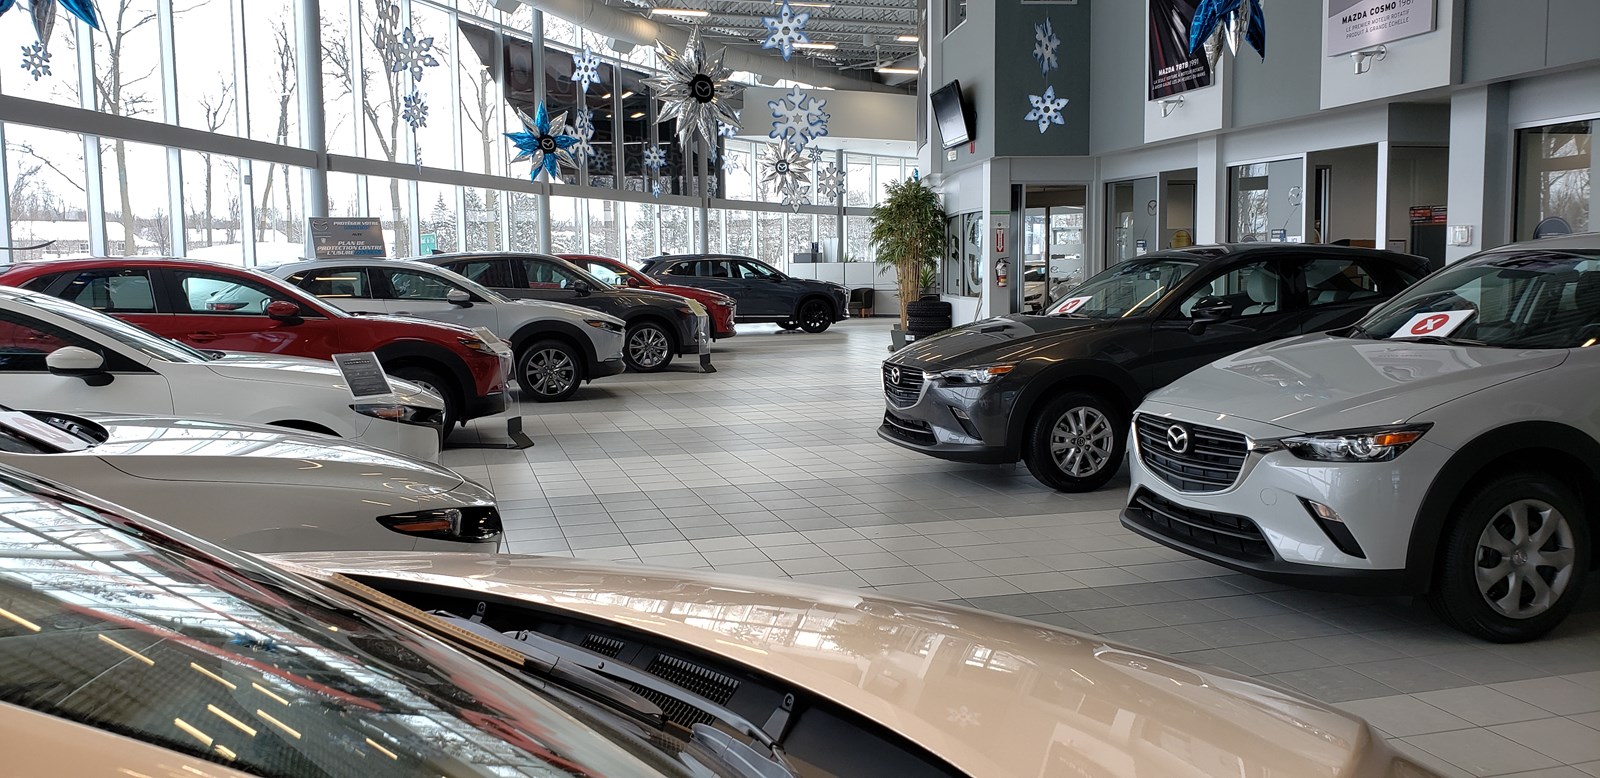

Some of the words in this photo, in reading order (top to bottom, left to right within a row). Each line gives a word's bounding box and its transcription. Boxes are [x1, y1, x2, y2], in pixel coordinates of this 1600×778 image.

[1342, 11, 1368, 24] MAZDA
[1370, 2, 1396, 16] COSMO
[1352, 20, 1370, 32] PREMIER
[1372, 14, 1390, 24] MOTEUR
[1390, 9, 1410, 20] ROTATIF
[1346, 30, 1364, 39] PRODUIT
[1370, 23, 1387, 32] GRANDE
[1388, 17, 1409, 28] ÉCHELLE
[1158, 66, 1174, 76] MAZDA
